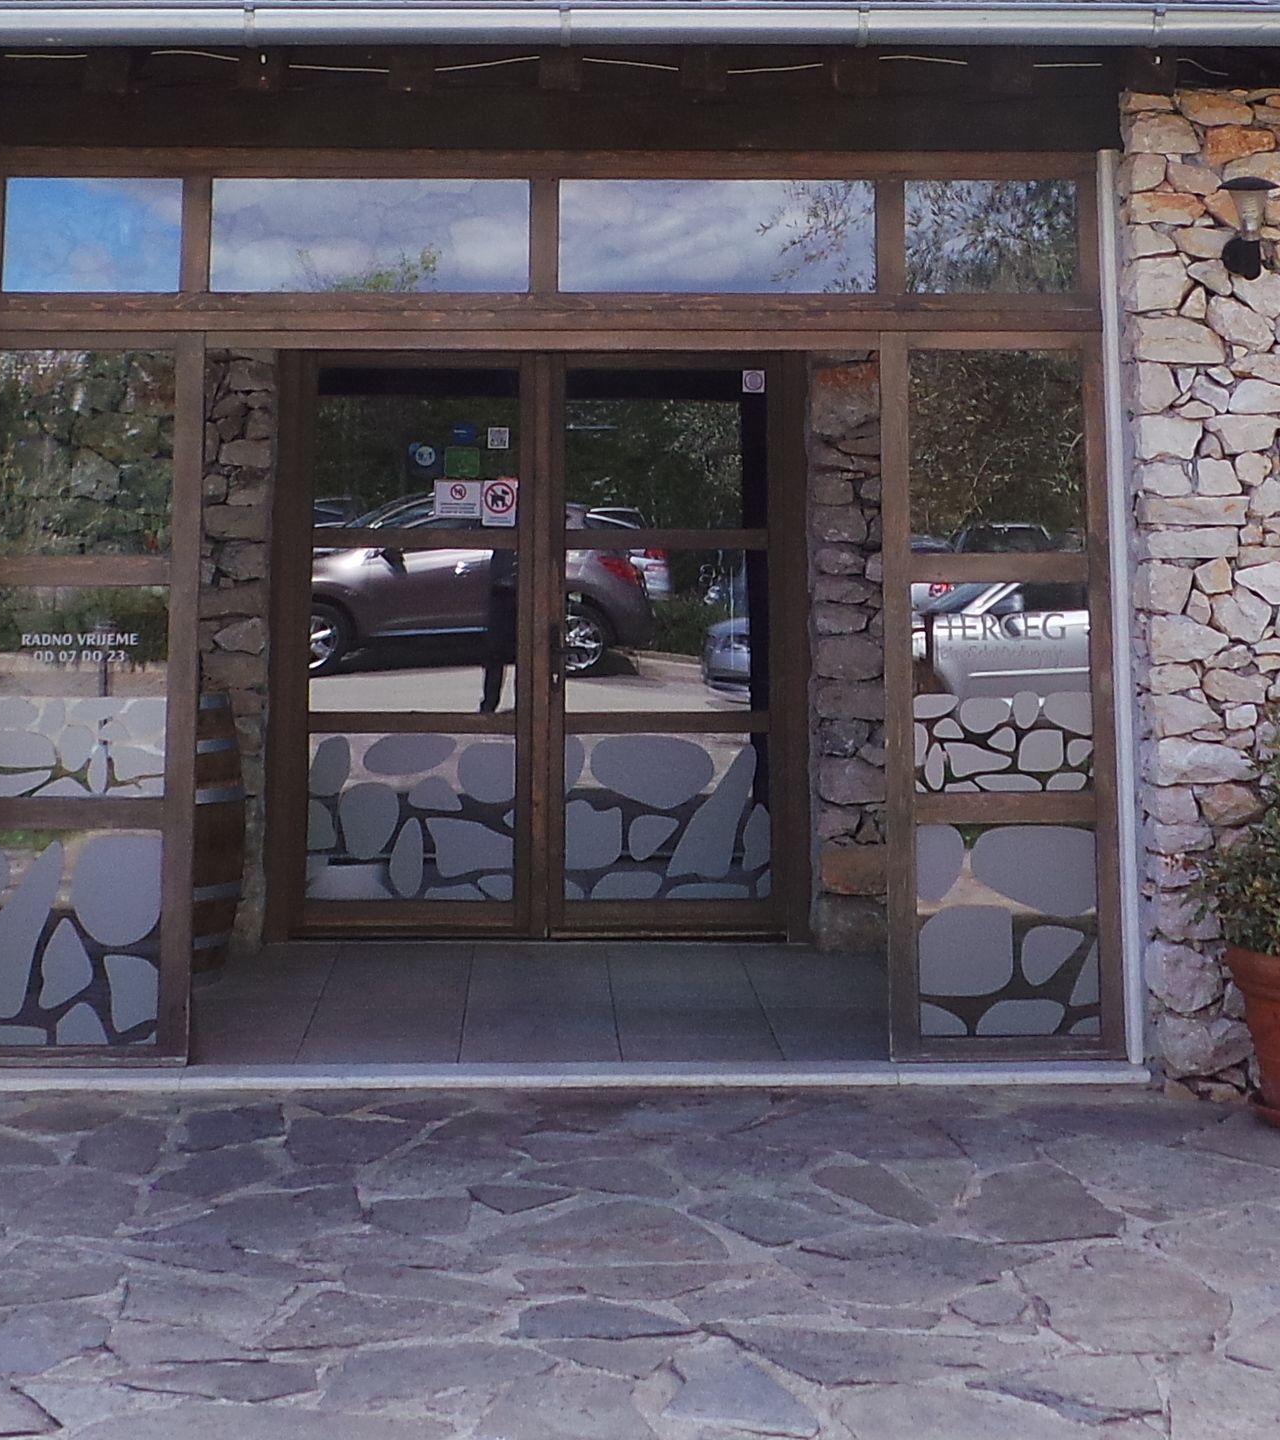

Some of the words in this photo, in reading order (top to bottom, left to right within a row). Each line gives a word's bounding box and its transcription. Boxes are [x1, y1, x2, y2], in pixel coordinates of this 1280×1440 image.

[21, 633, 73, 646] RADNO
[77, 633, 139, 646] VRIJEME
[33, 650, 54, 662] OD
[59, 650, 77, 662] 07
[81, 650, 102, 662] DO
[107, 650, 125, 662] 23
